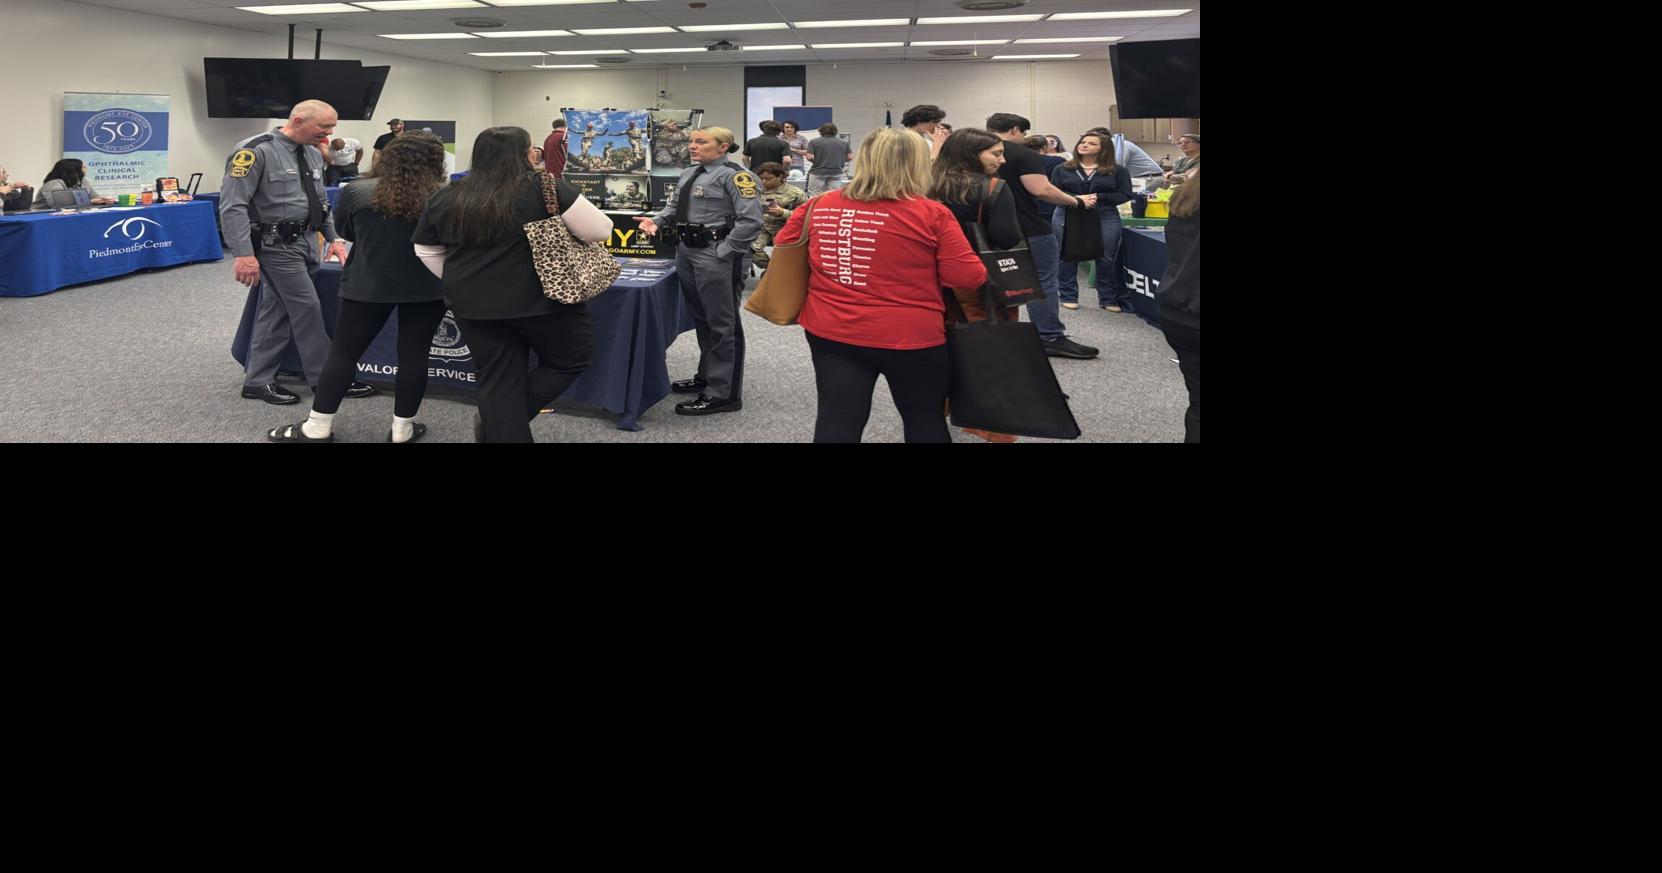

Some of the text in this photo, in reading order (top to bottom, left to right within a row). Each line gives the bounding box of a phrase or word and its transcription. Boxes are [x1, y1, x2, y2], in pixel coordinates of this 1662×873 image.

[93, 121, 139, 145] 50
[838, 208, 855, 285] RUSTBURG
[443, 347, 469, 355] POLICE
[427, 367, 477, 383] ERVICE
